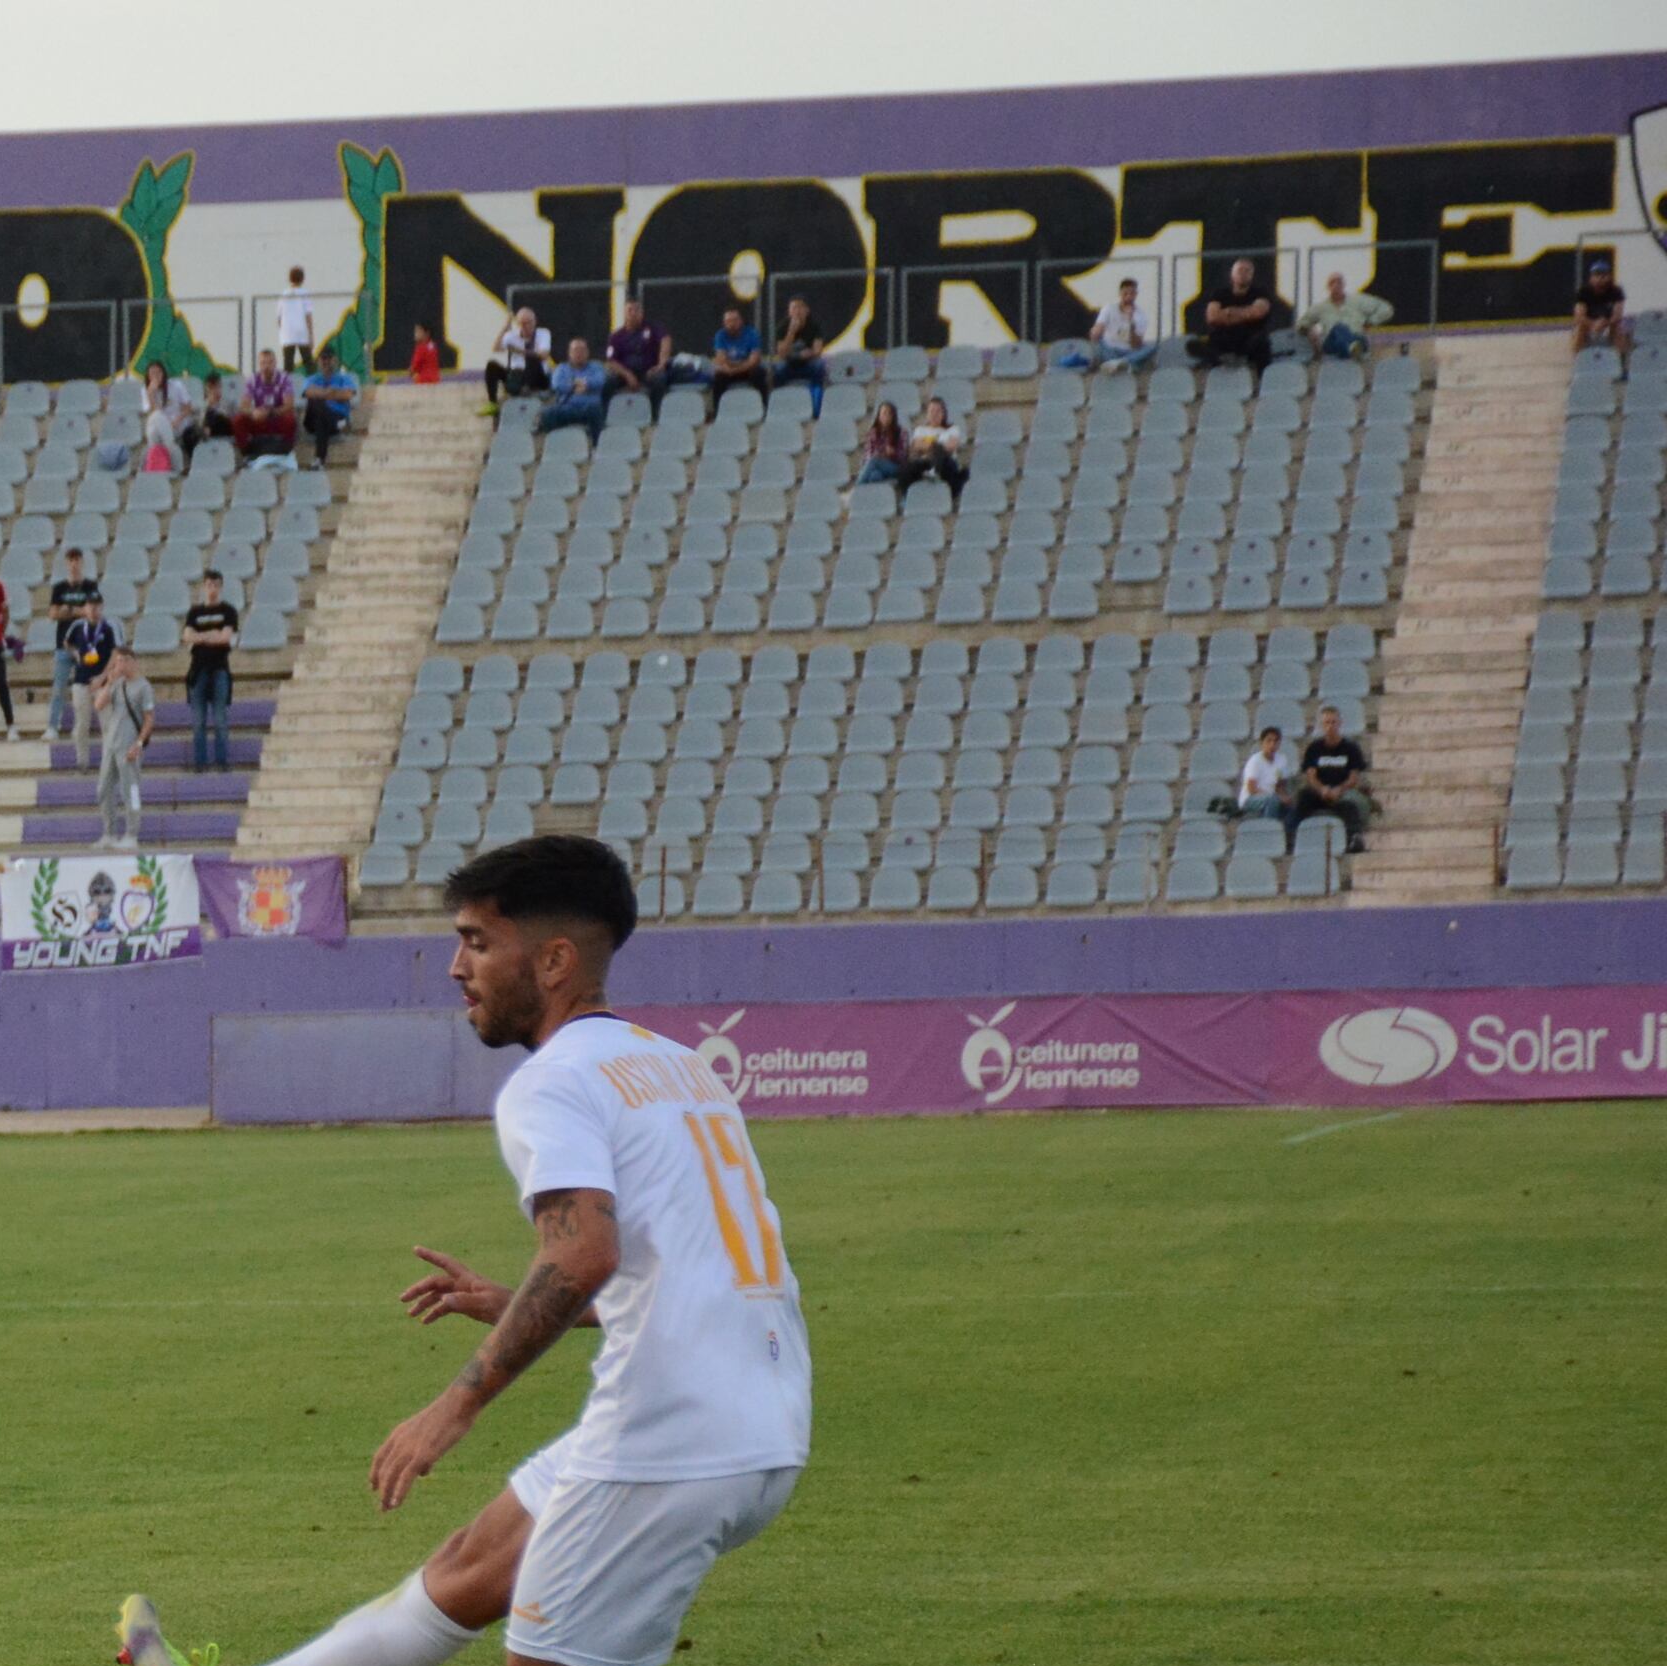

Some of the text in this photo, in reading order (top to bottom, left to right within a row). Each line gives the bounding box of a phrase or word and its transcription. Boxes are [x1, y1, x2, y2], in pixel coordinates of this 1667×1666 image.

[373, 133, 1617, 372] NORTE
[12, 928, 190, 969] YOUNG TNF
[1467, 1014, 1609, 1074] Solar
